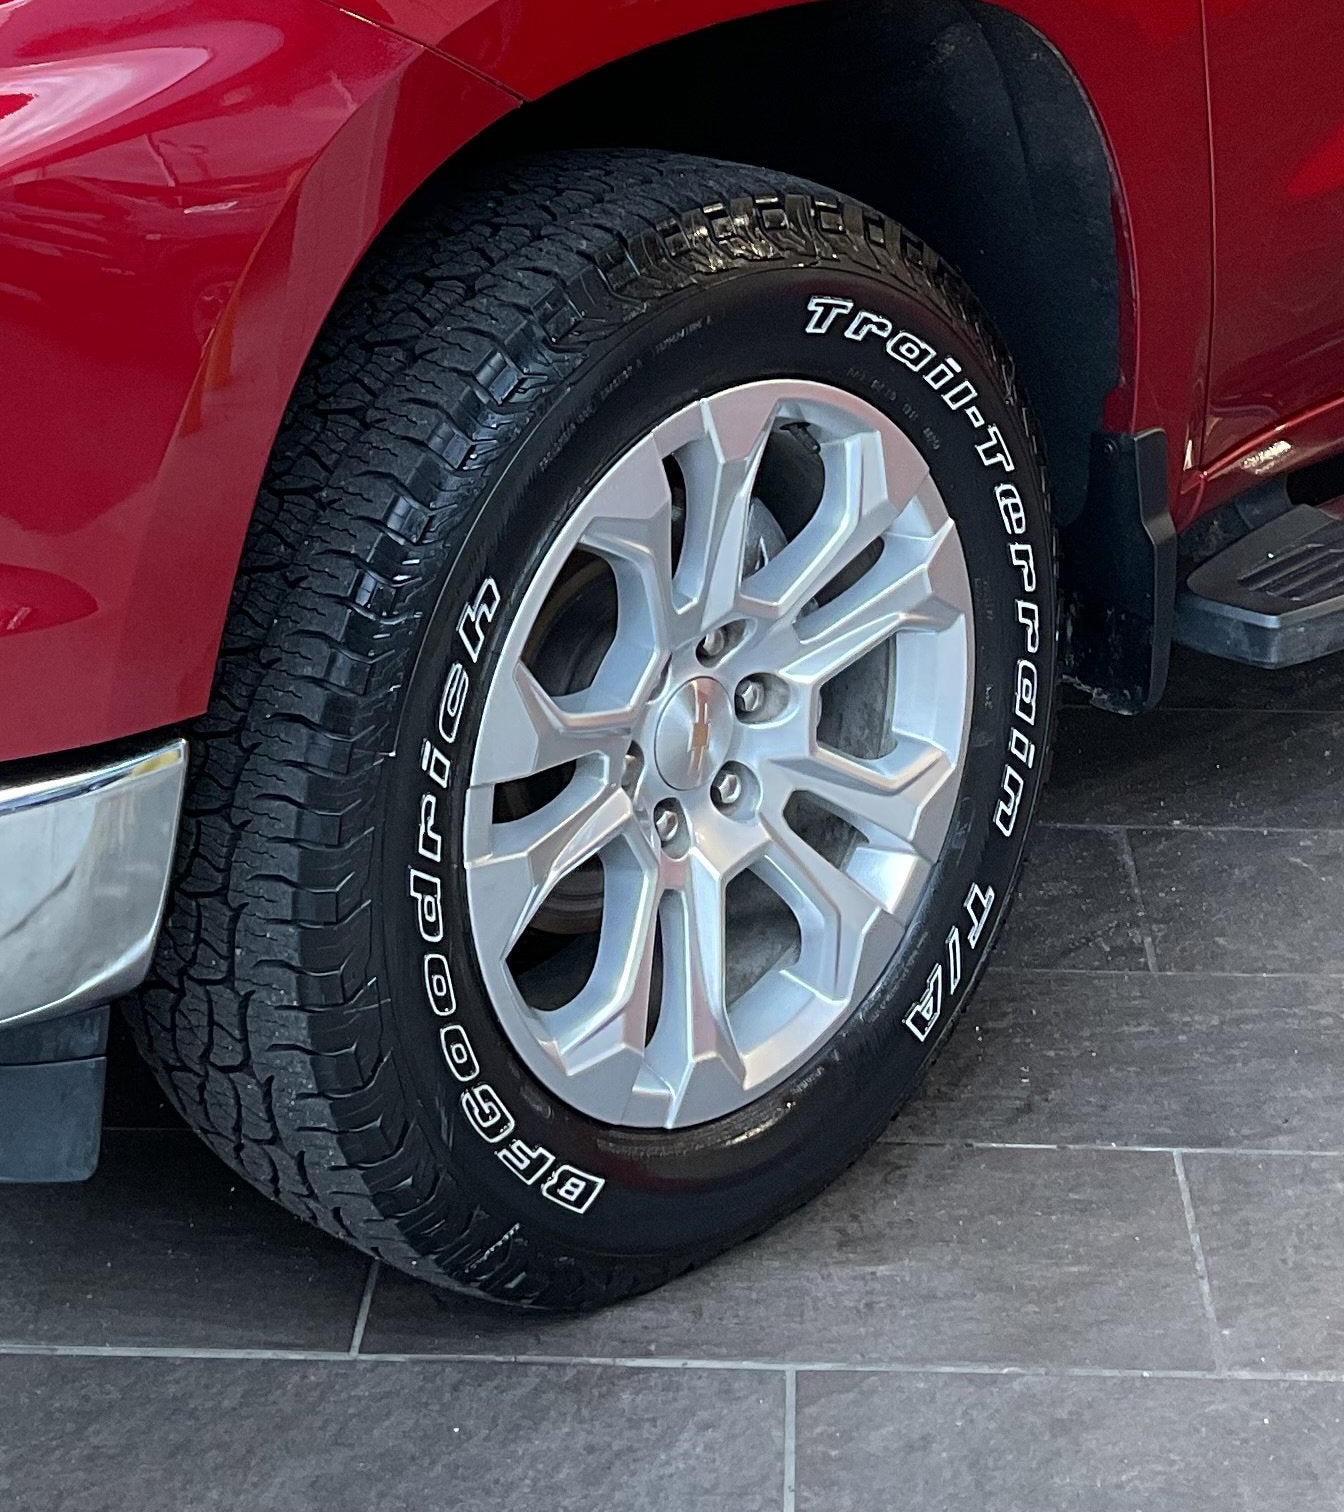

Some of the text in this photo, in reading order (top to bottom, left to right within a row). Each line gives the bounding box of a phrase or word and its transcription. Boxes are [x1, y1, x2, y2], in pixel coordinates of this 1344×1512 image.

[803, 294, 1040, 838] Trail-Terrain
[408, 576, 606, 1215] BFGoodrich
[900, 884, 996, 1043] T/A
